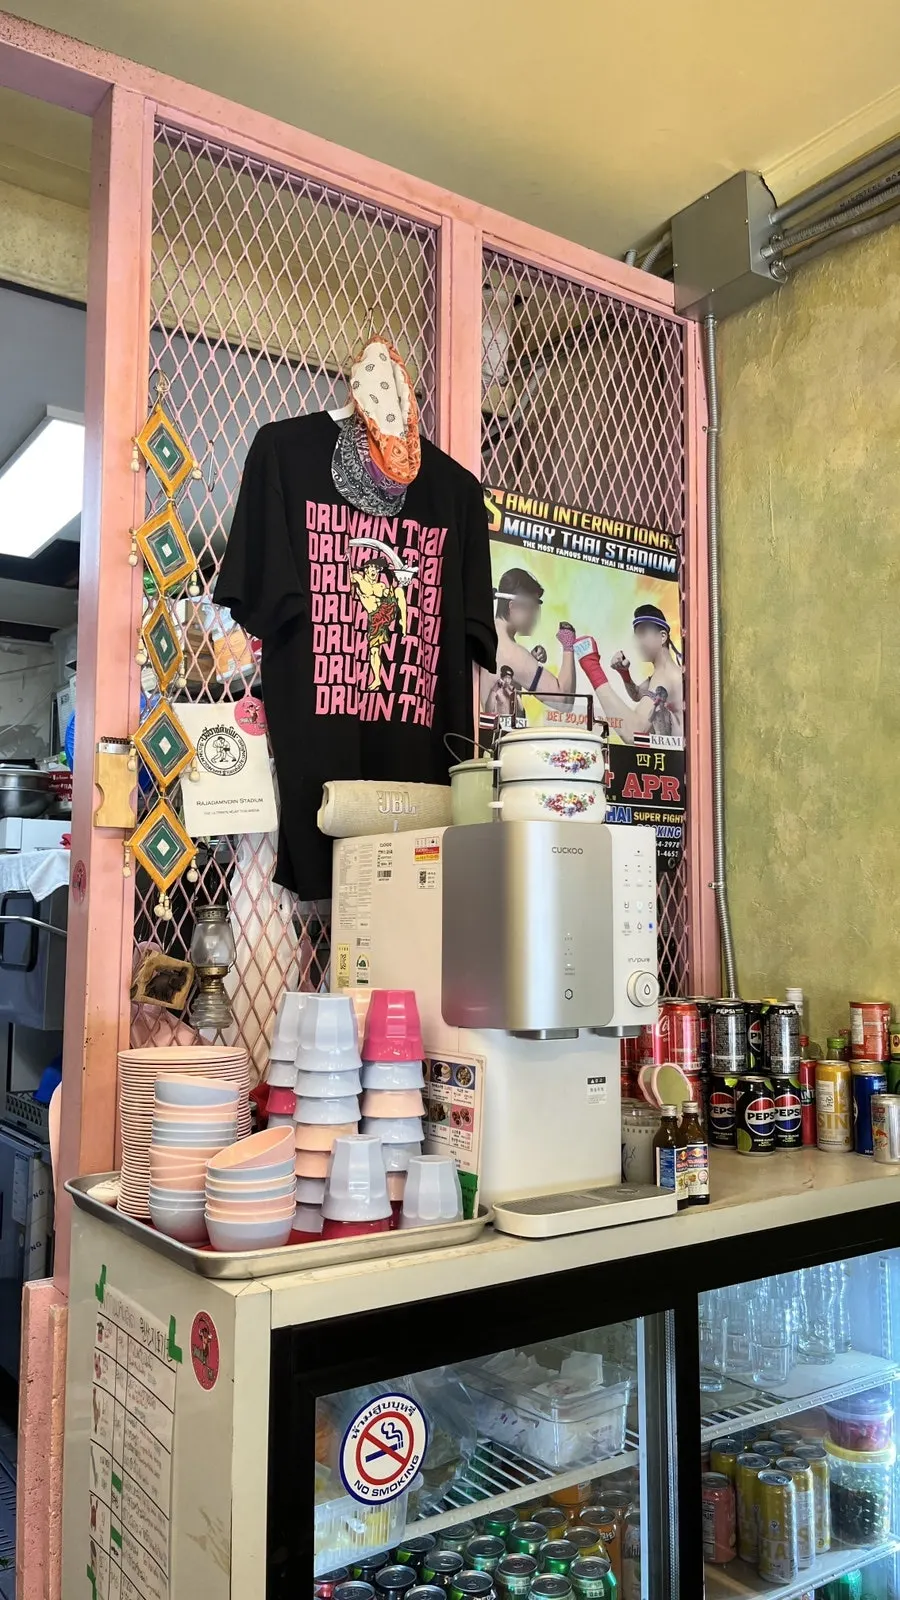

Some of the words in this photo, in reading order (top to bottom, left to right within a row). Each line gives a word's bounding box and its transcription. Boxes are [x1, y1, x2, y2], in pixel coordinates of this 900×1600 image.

[504, 517, 555, 544] MUAY
[561, 530, 600, 555] THAI
[605, 542, 677, 574] STADIUM
[523, 540, 537, 550] THE
[537, 544, 555, 554] MOST
[556, 548, 581, 561] FAMOUS
[583, 553, 600, 565] MUAY
[601, 558, 616, 568] THAI
[617, 562, 625, 570] IN
[625, 564, 645, 574] SAMUI
[547, 710, 564, 723] BET
[651, 734, 682, 747] KRAM
[635, 753, 666, 772] 四月
[622, 772, 681, 802] APR
[376, 790, 417, 815] JBL
[605, 806, 632, 824] HAI
[633, 811, 661, 822] SUPER
[662, 813, 684, 823] FIGHT
[551, 846, 584, 856] CUCKOO
[656, 840, 680, 849] 4-2978
[709, 1106, 736, 1115] EPS
[747, 1111, 775, 1121] PEPS
[774, 1108, 800, 1117] PEPS
[817, 1112, 849, 1130] SIN
[351, 1401, 417, 1440] ห้ามสูบบุหรี่
[354, 1479, 370, 1495] NO
[371, 1454, 420, 1497] SMOKING
